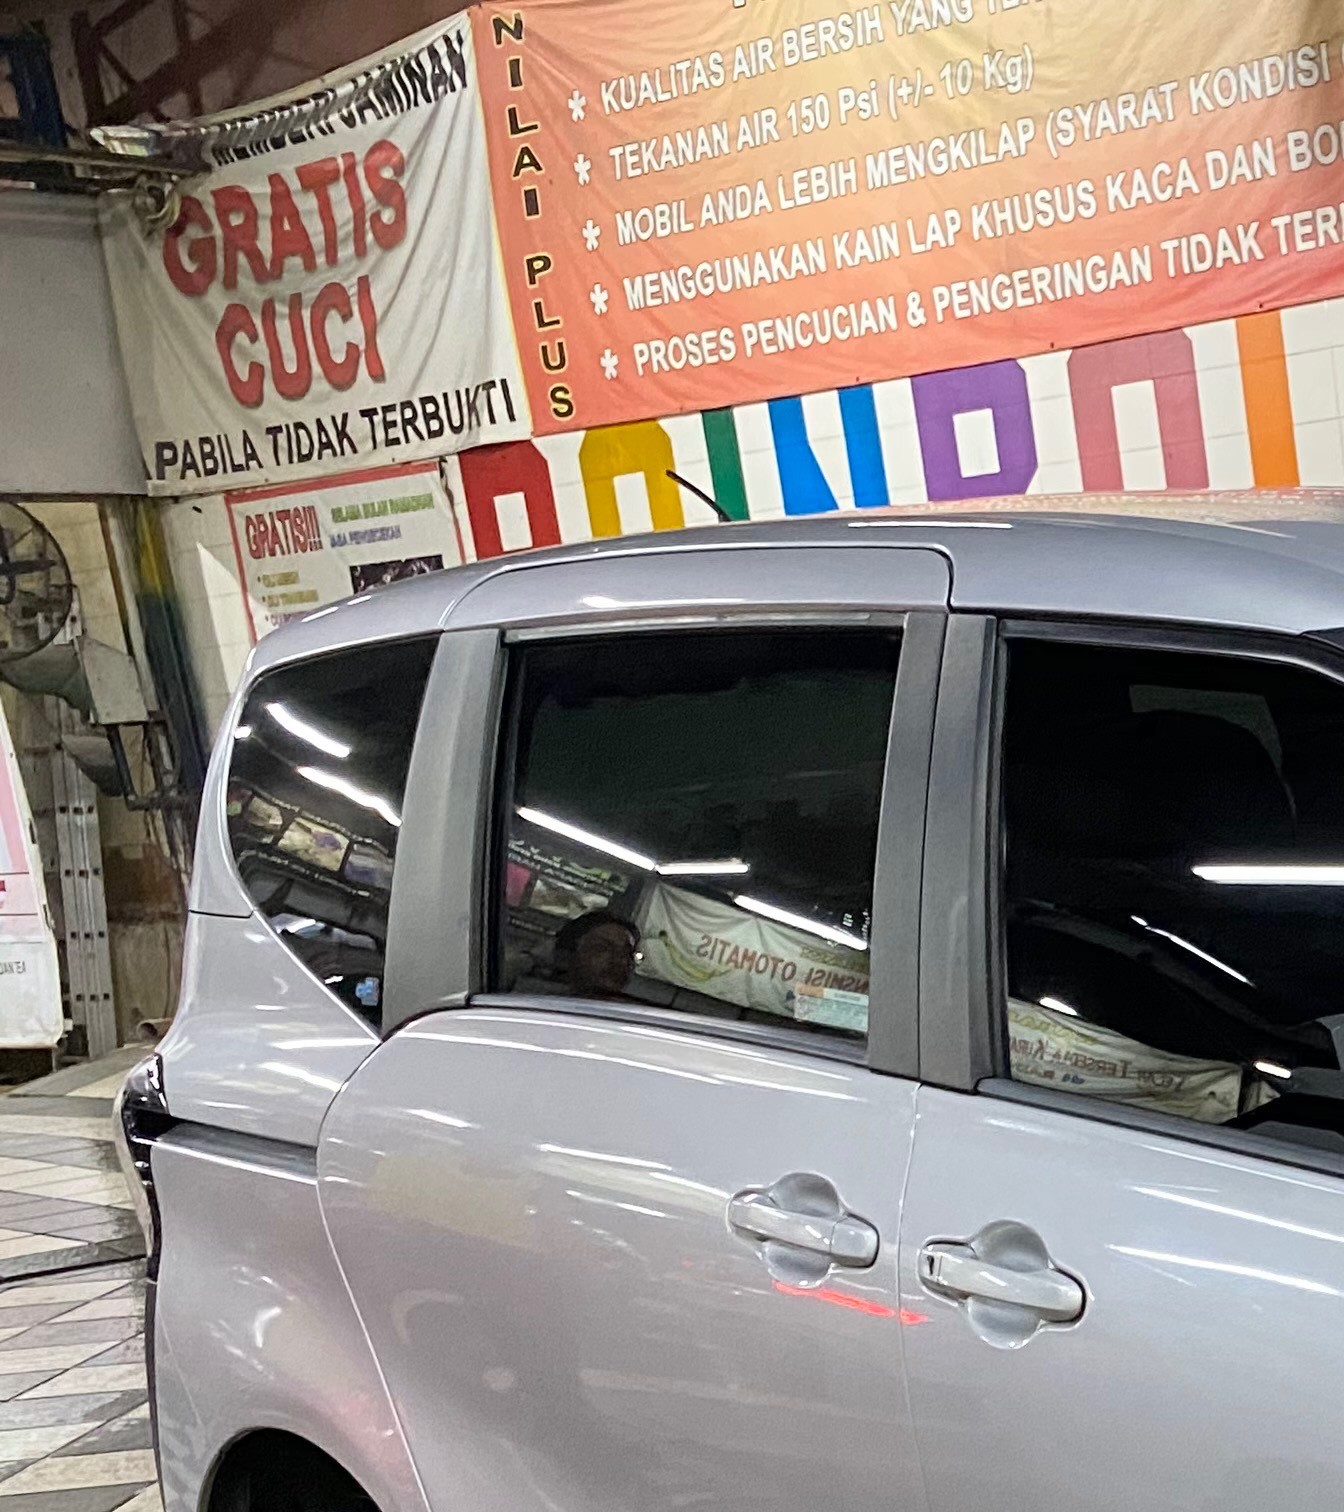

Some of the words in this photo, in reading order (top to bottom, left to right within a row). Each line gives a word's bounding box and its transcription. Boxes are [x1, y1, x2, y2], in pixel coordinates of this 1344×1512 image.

[601, 50, 725, 115] KUALITAS
[733, 37, 777, 82] AIR
[782, 5, 884, 67] BERSIH
[889, 0, 974, 36] YANG
[609, 121, 731, 181] TEKANAN
[736, 108, 779, 151] AIR
[786, 92, 831, 137] 150
[838, 79, 880, 122] Psi
[939, 58, 974, 100] 10
[982, 43, 1035, 94] Kg)
[492, 12, 543, 218] NILAI
[526, 254, 575, 419] PLUS
[616, 200, 694, 246] MOBIL
[700, 180, 773, 230] ANDA
[778, 158, 859, 211] LEBIH
[866, 117, 1035, 197] MENGKILAP
[1045, 81, 1179, 158] (SYARAT
[1189, 41, 1330, 116] KONDISI
[162, 139, 408, 297] GRATIS
[624, 237, 827, 312] MENGGUNAKAN
[833, 219, 900, 269] KAIN
[908, 205, 964, 256] LAP
[972, 180, 1098, 242] KHUSUS
[1106, 155, 1199, 211] KACA
[1206, 138, 1277, 192] DAN
[214, 275, 387, 408] CUCI
[633, 329, 738, 377] PROSES
[744, 294, 898, 359] PENCUCIAN
[906, 285, 928, 329] &
[934, 247, 1154, 324] PENGERINGAN
[1160, 231, 1264, 281] TIDAK
[265, 412, 359, 467] TIDAK
[359, 378, 518, 450] TERBUKTI
